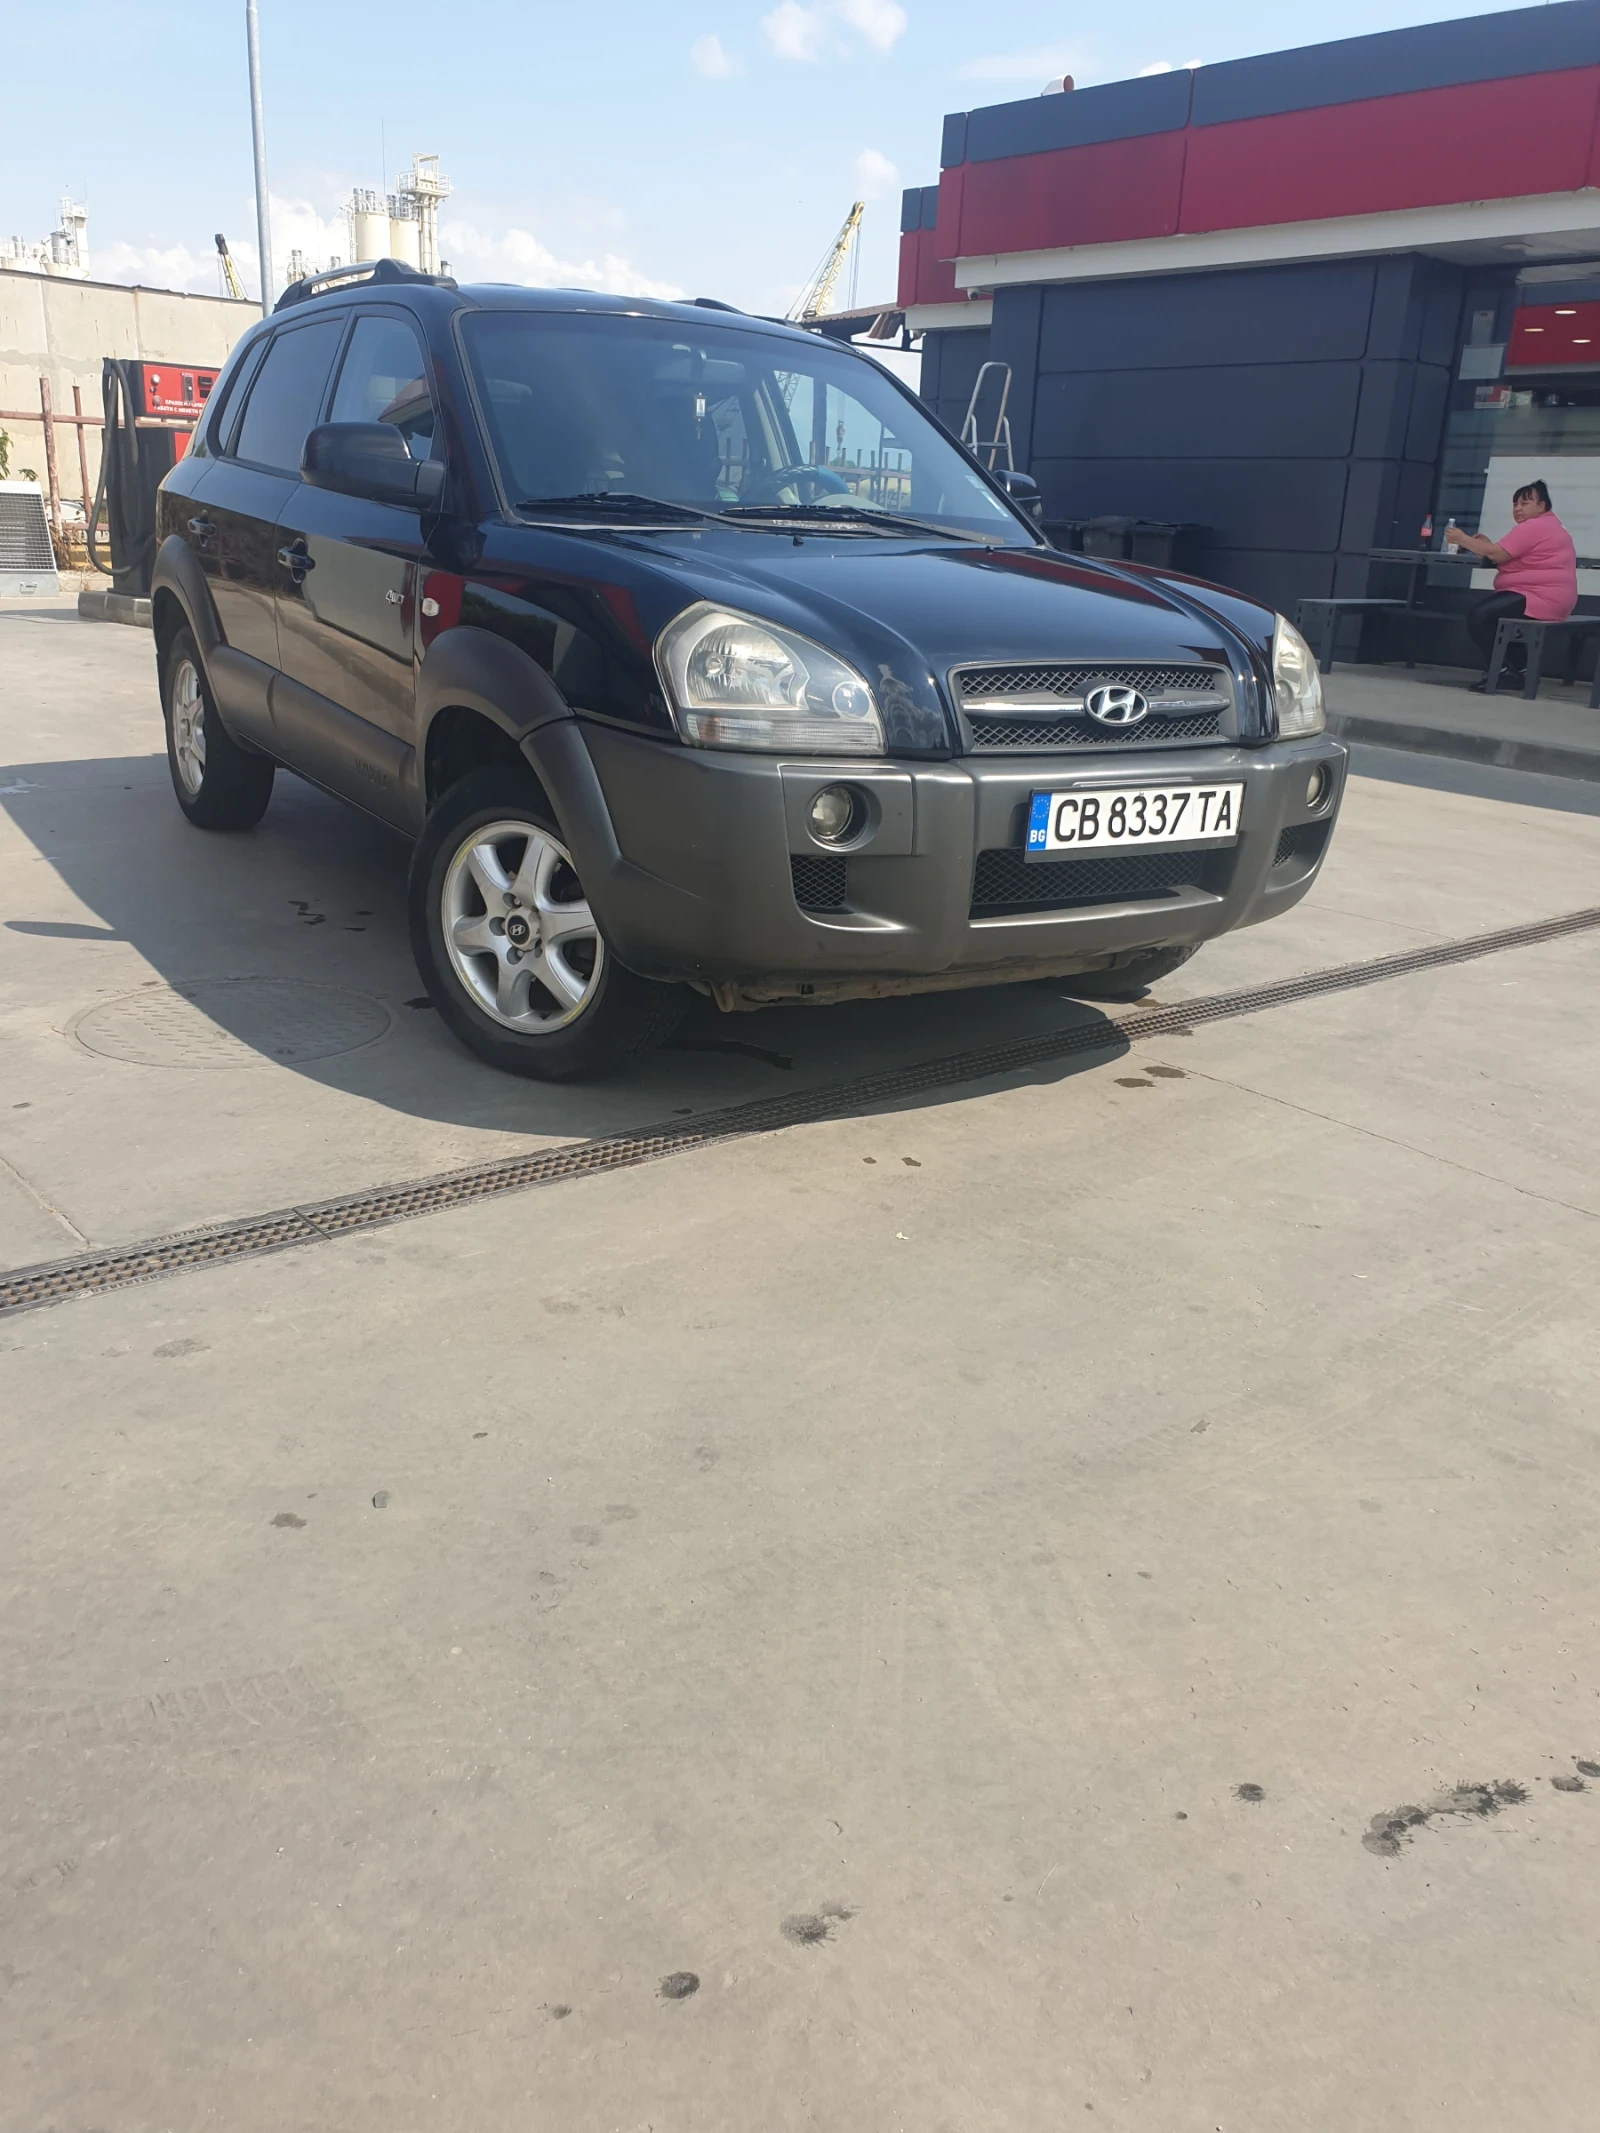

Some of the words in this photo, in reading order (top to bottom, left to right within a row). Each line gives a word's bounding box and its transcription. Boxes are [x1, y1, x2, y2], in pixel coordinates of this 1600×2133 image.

[1054, 798, 1100, 842] CB
[1108, 793, 1190, 838] 8337
[1198, 790, 1231, 832] TA
[1029, 829, 1046, 843] BG
